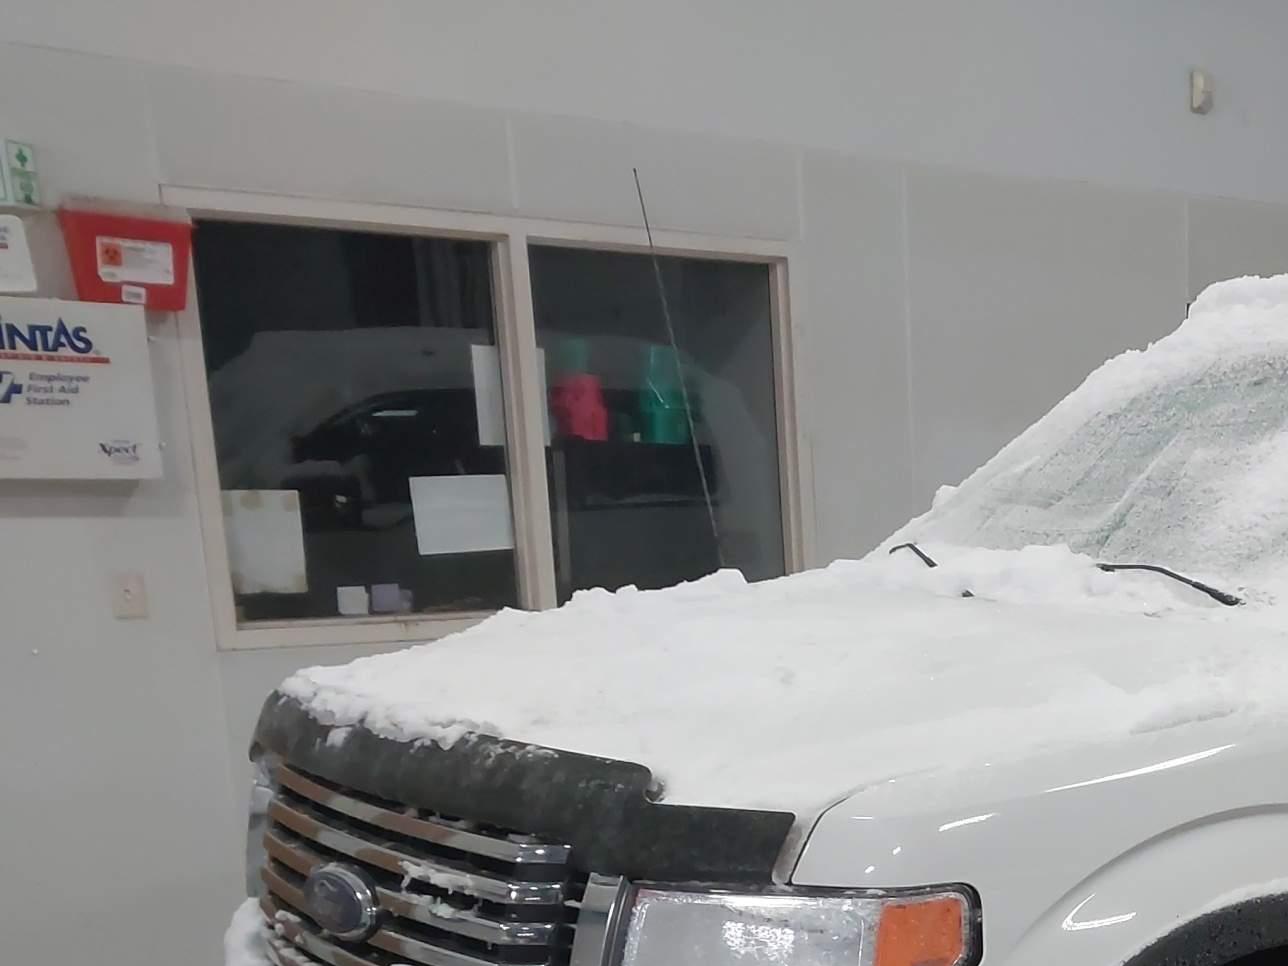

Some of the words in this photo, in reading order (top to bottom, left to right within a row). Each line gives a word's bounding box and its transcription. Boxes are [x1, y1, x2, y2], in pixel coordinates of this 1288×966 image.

[28, 372, 90, 383] Employee
[26, 384, 54, 394] First
[58, 384, 80, 394] Aid
[26, 397, 71, 406] Station
